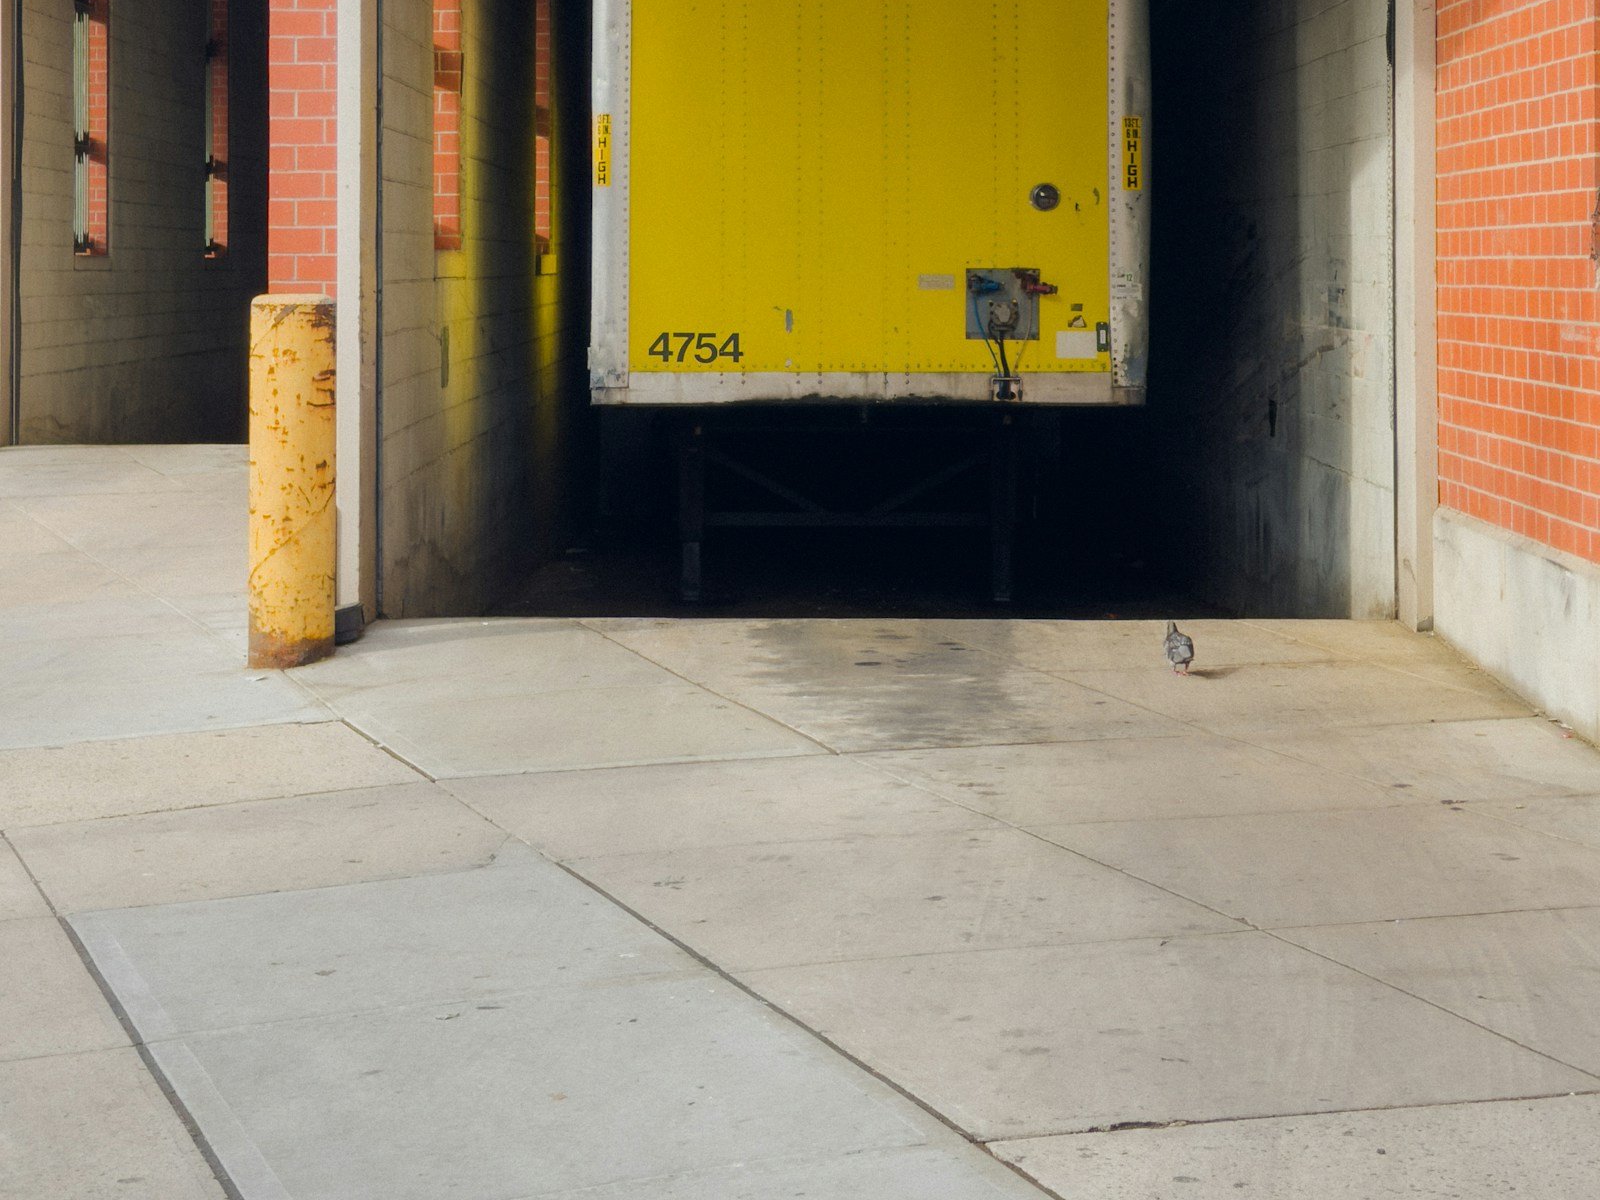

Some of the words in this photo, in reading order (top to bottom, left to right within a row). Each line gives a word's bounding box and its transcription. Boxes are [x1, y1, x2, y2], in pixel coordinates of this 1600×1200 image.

[598, 137, 607, 185] HIGH
[1127, 140, 1138, 188] HIGH
[648, 332, 744, 363] 4754
